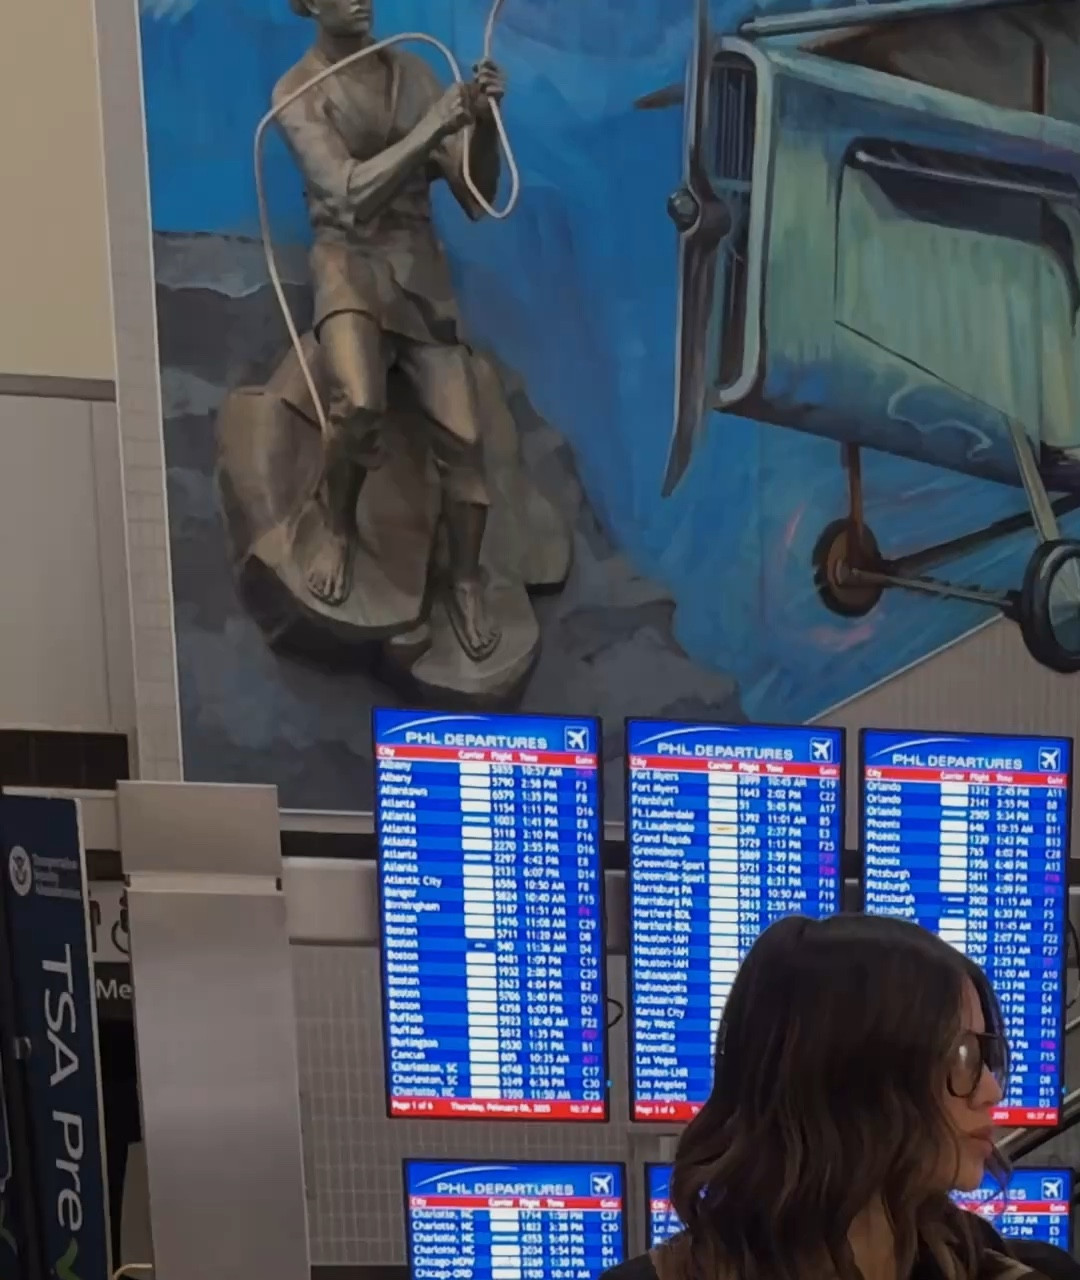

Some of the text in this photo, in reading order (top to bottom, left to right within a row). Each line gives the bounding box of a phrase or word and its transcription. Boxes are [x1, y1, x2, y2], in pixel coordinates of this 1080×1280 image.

[405, 732, 548, 749] PHL DEPARTURES
[657, 742, 793, 760] PHL DEPARTURES
[892, 754, 1023, 770] PHL DEPARTURES
[632, 784, 649, 793] Fort
[788, 791, 801, 799] PM
[867, 783, 901, 792] Orlando
[1017, 789, 1029, 797] PM
[544, 806, 558, 814] PM
[423, 876, 441, 888] City
[551, 882, 564, 891] AM
[667, 1009, 684, 1019] City
[556, 1055, 569, 1064] AM
[636, 1056, 650, 1064] Las
[42, 944, 86, 1232] TSA Pre
[436, 1182, 574, 1195] PHL DEPARTURES
